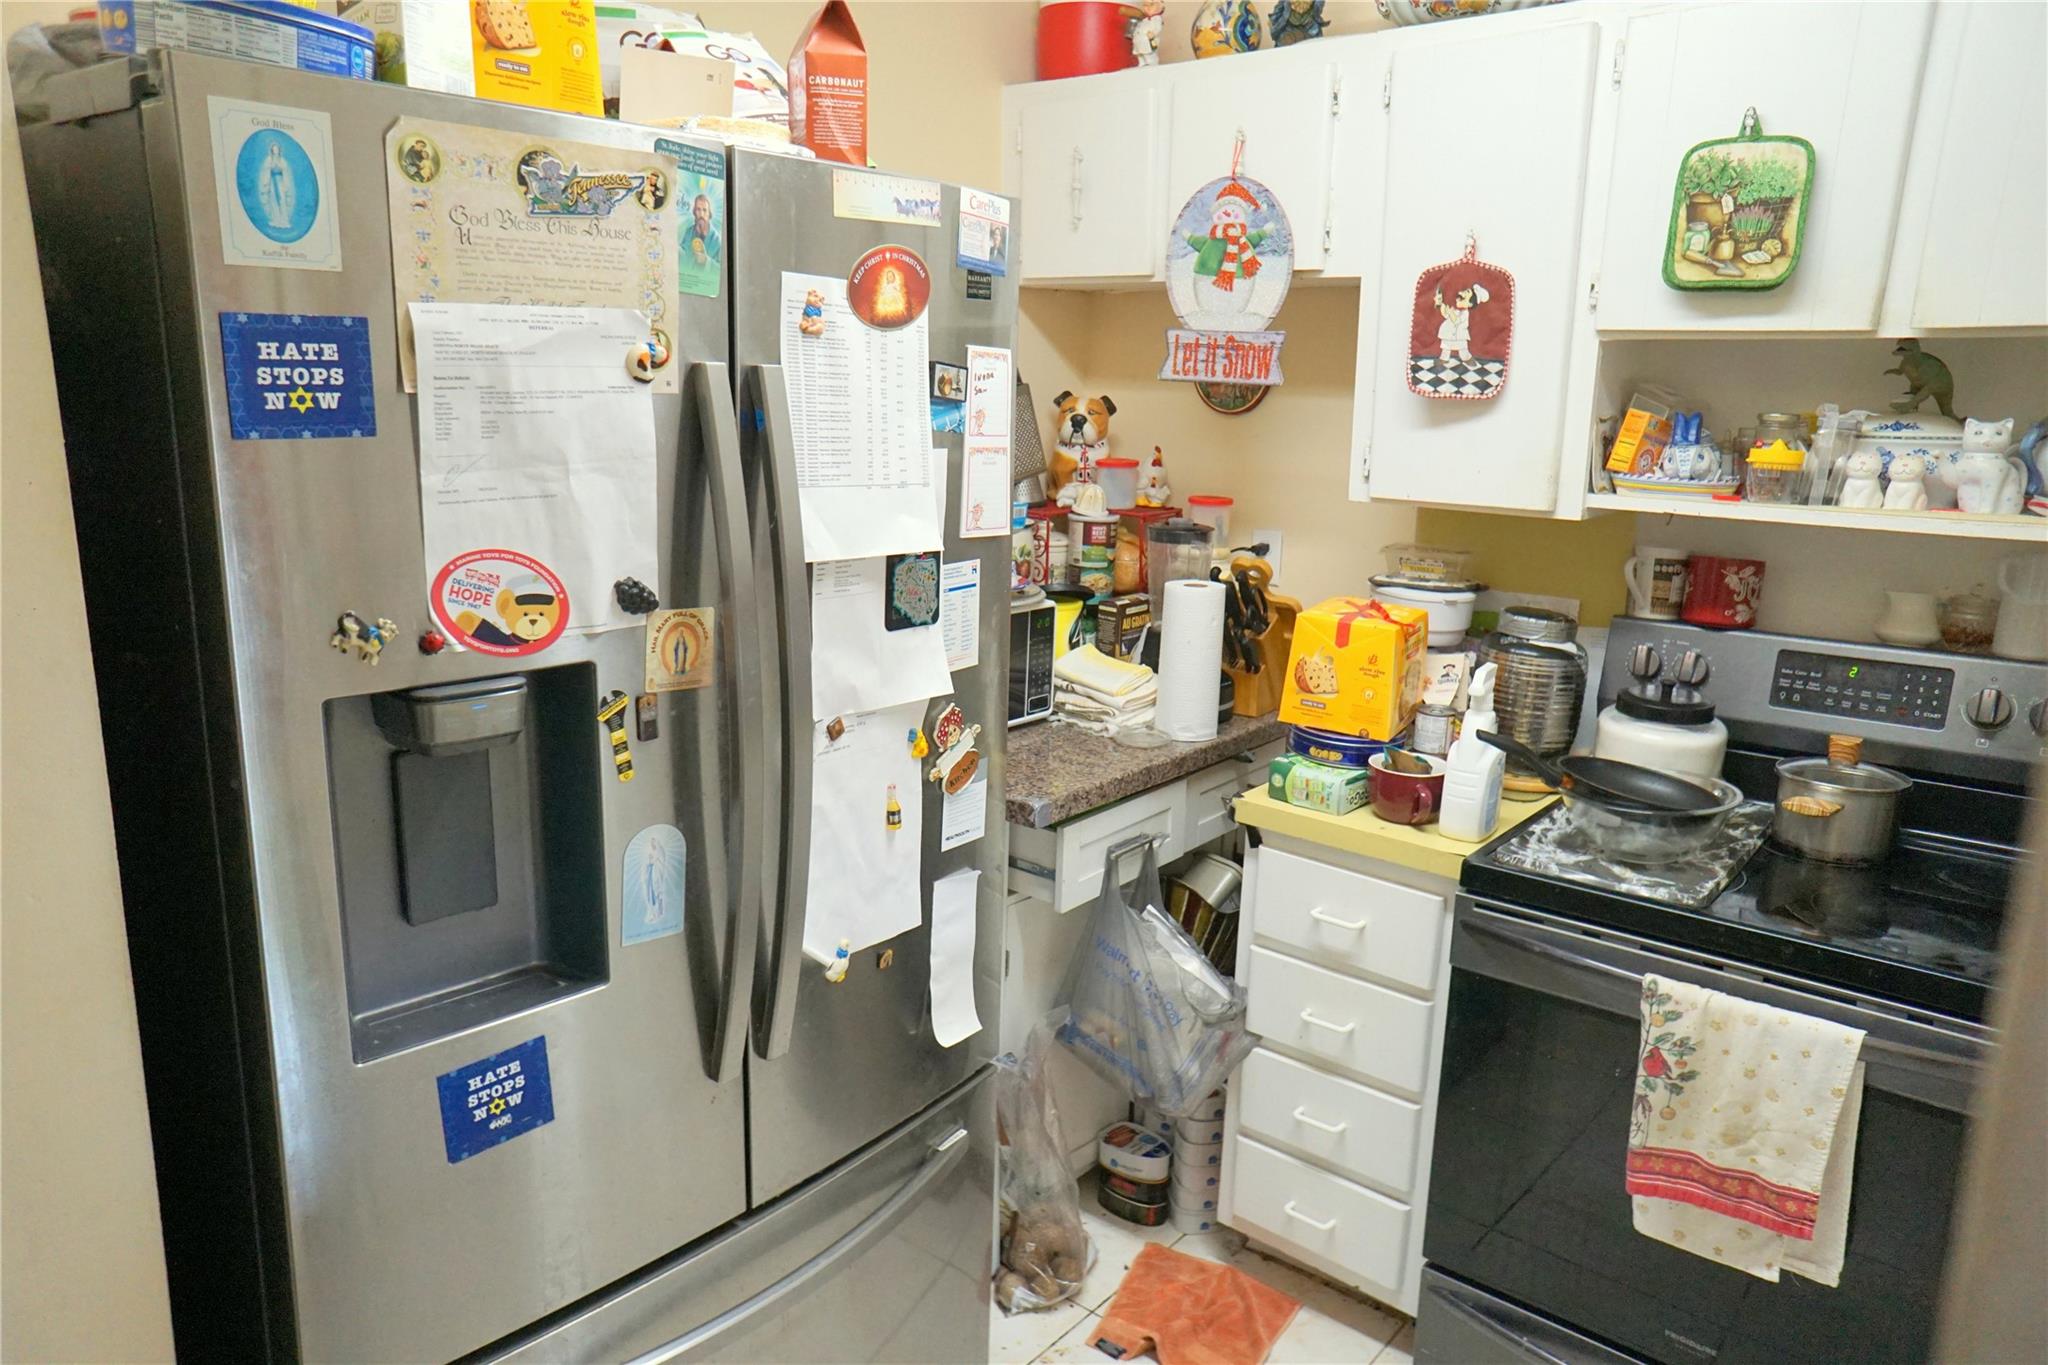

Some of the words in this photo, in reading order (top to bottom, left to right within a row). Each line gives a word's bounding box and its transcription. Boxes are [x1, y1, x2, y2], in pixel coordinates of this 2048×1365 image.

[251, 117, 270, 128] God
[272, 119, 296, 131] Bless
[568, 173, 633, 206] Tennessee
[449, 204, 489, 228] God
[495, 207, 542, 233] Bless
[545, 217, 578, 236] This
[582, 218, 632, 242] House
[853, 266, 865, 284] KEEP
[864, 254, 883, 270] CHRIST
[898, 253, 926, 279] CHRISTMAS
[257, 341, 339, 361] HATE
[1172, 334, 1199, 377] Let
[1204, 335, 1219, 378] it
[1222, 334, 1275, 380] Snow
[257, 367, 344, 386] STOPS
[500, 553, 514, 561] FOR
[514, 556, 531, 567] TOTS
[449, 585, 493, 606] HOPE
[452, 577, 495, 594] DELIVERING
[448, 597, 466, 607] SINCE
[656, 615, 672, 635] MARY
[672, 610, 689, 620] FULL
[1848, 666, 1859, 678] 2
[468, 1060, 521, 1091] HATE
[468, 1075, 525, 1108] STOPS
